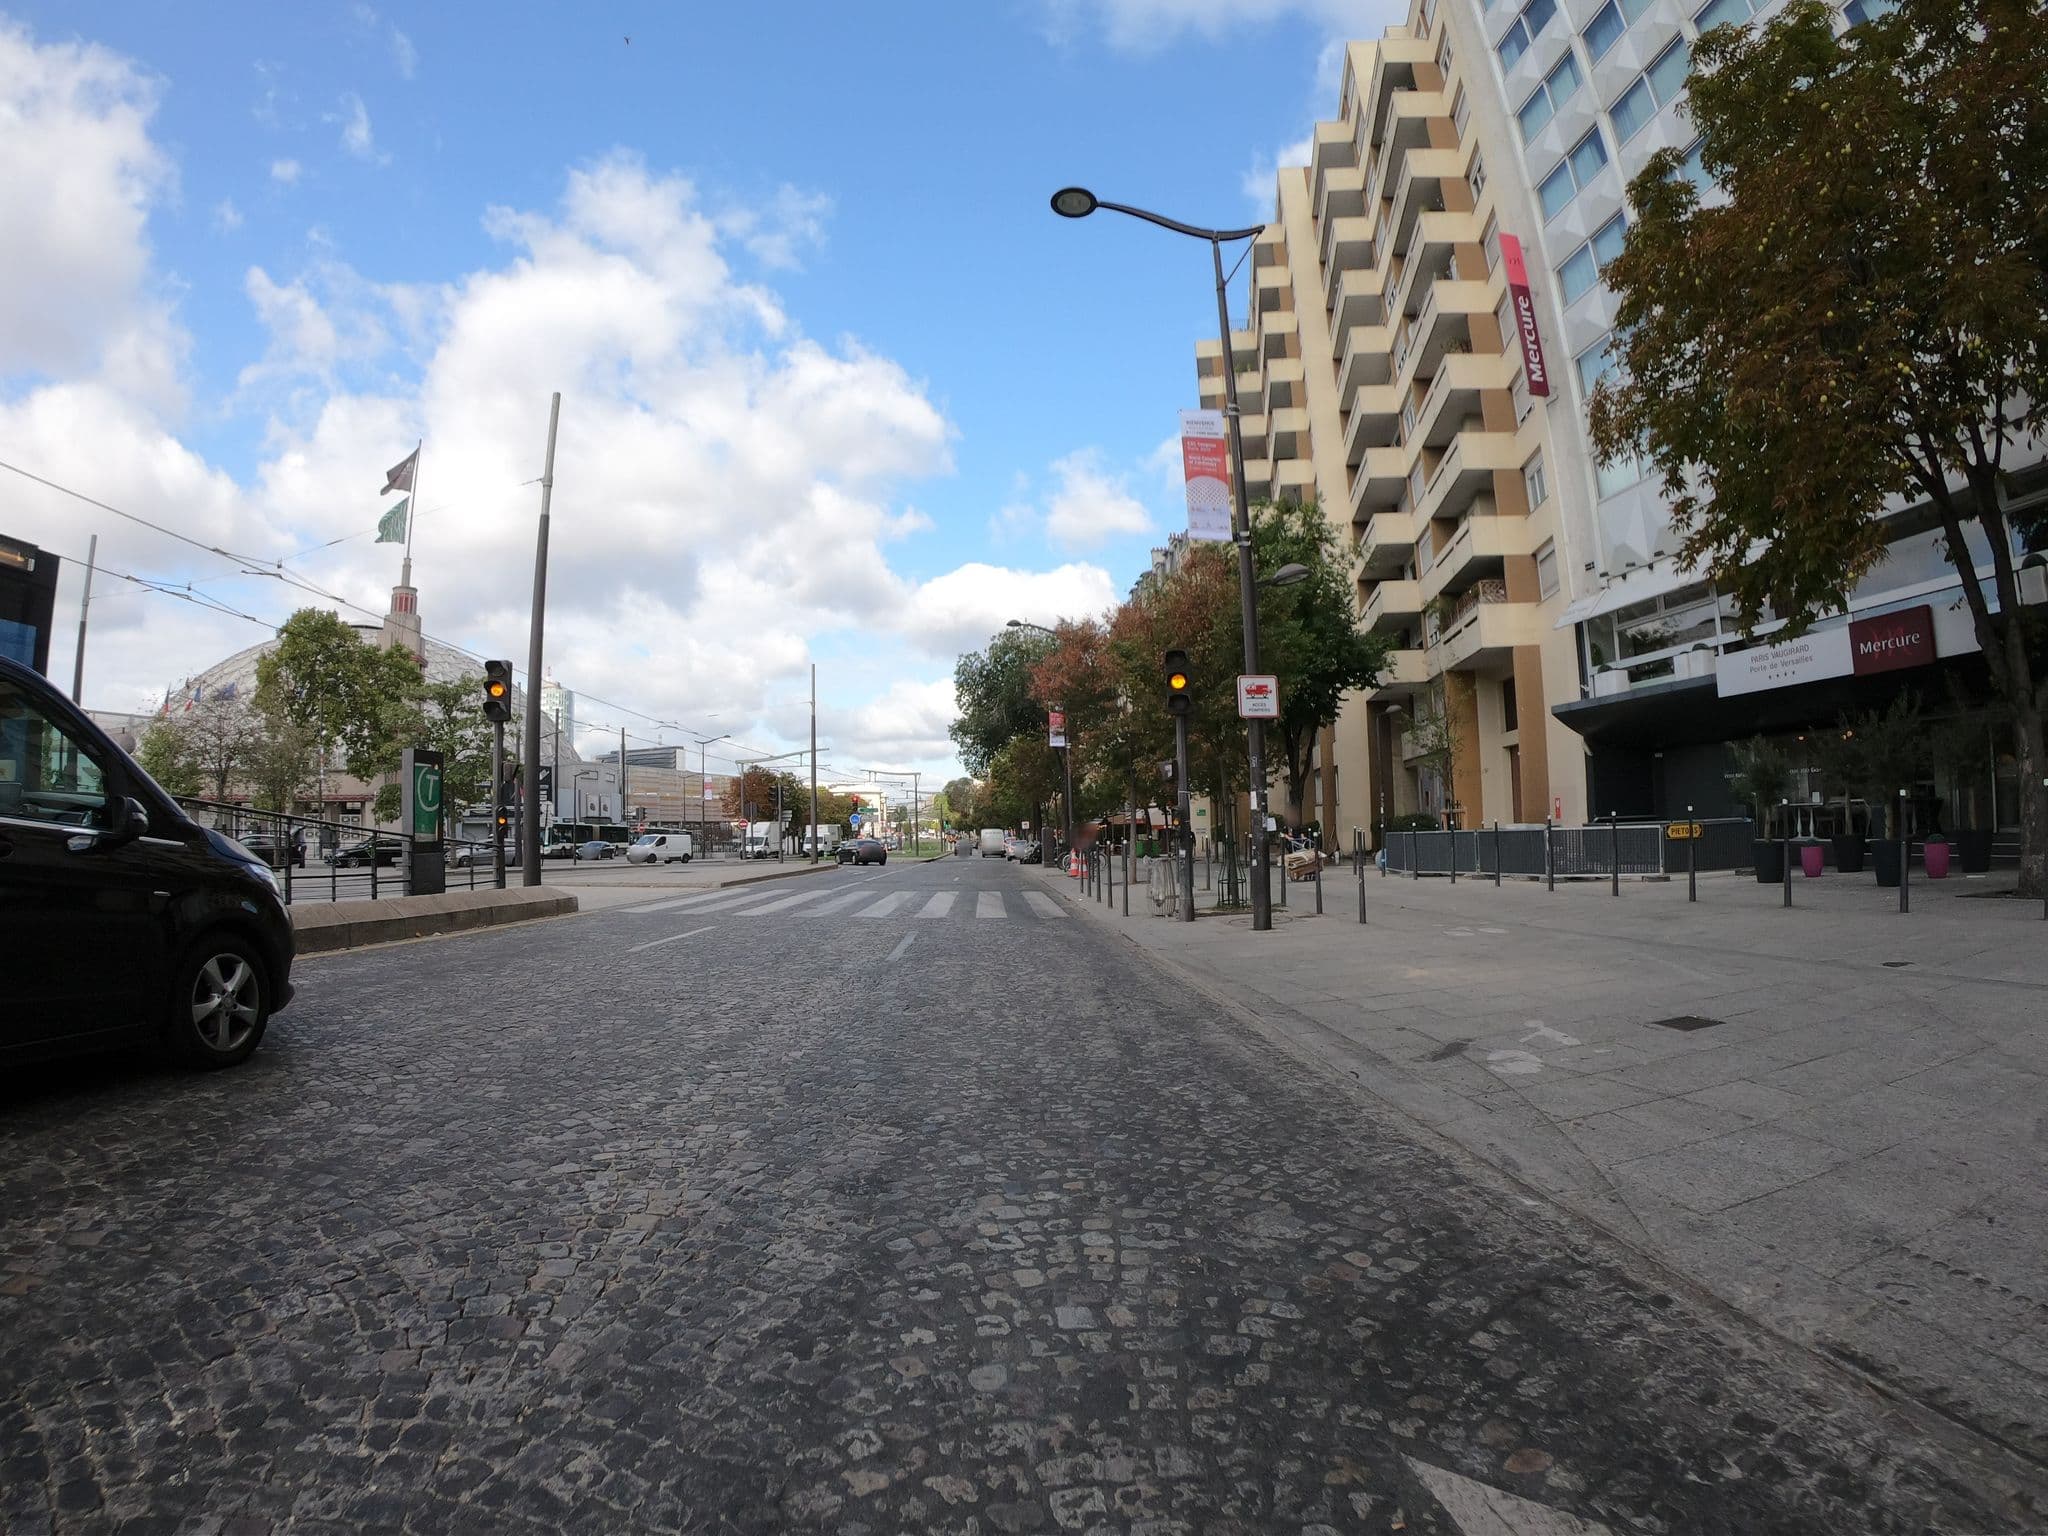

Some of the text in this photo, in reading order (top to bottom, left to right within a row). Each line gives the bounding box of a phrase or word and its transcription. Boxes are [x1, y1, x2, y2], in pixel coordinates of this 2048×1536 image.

[1518, 296, 1544, 383] Mercure
[1860, 632, 1920, 655] Mercure
[1749, 655, 1813, 673] Porte de Versailles
[1750, 644, 1810, 664] PARIS VAUGIRARD
[1670, 826, 1699, 836] PIETOS
